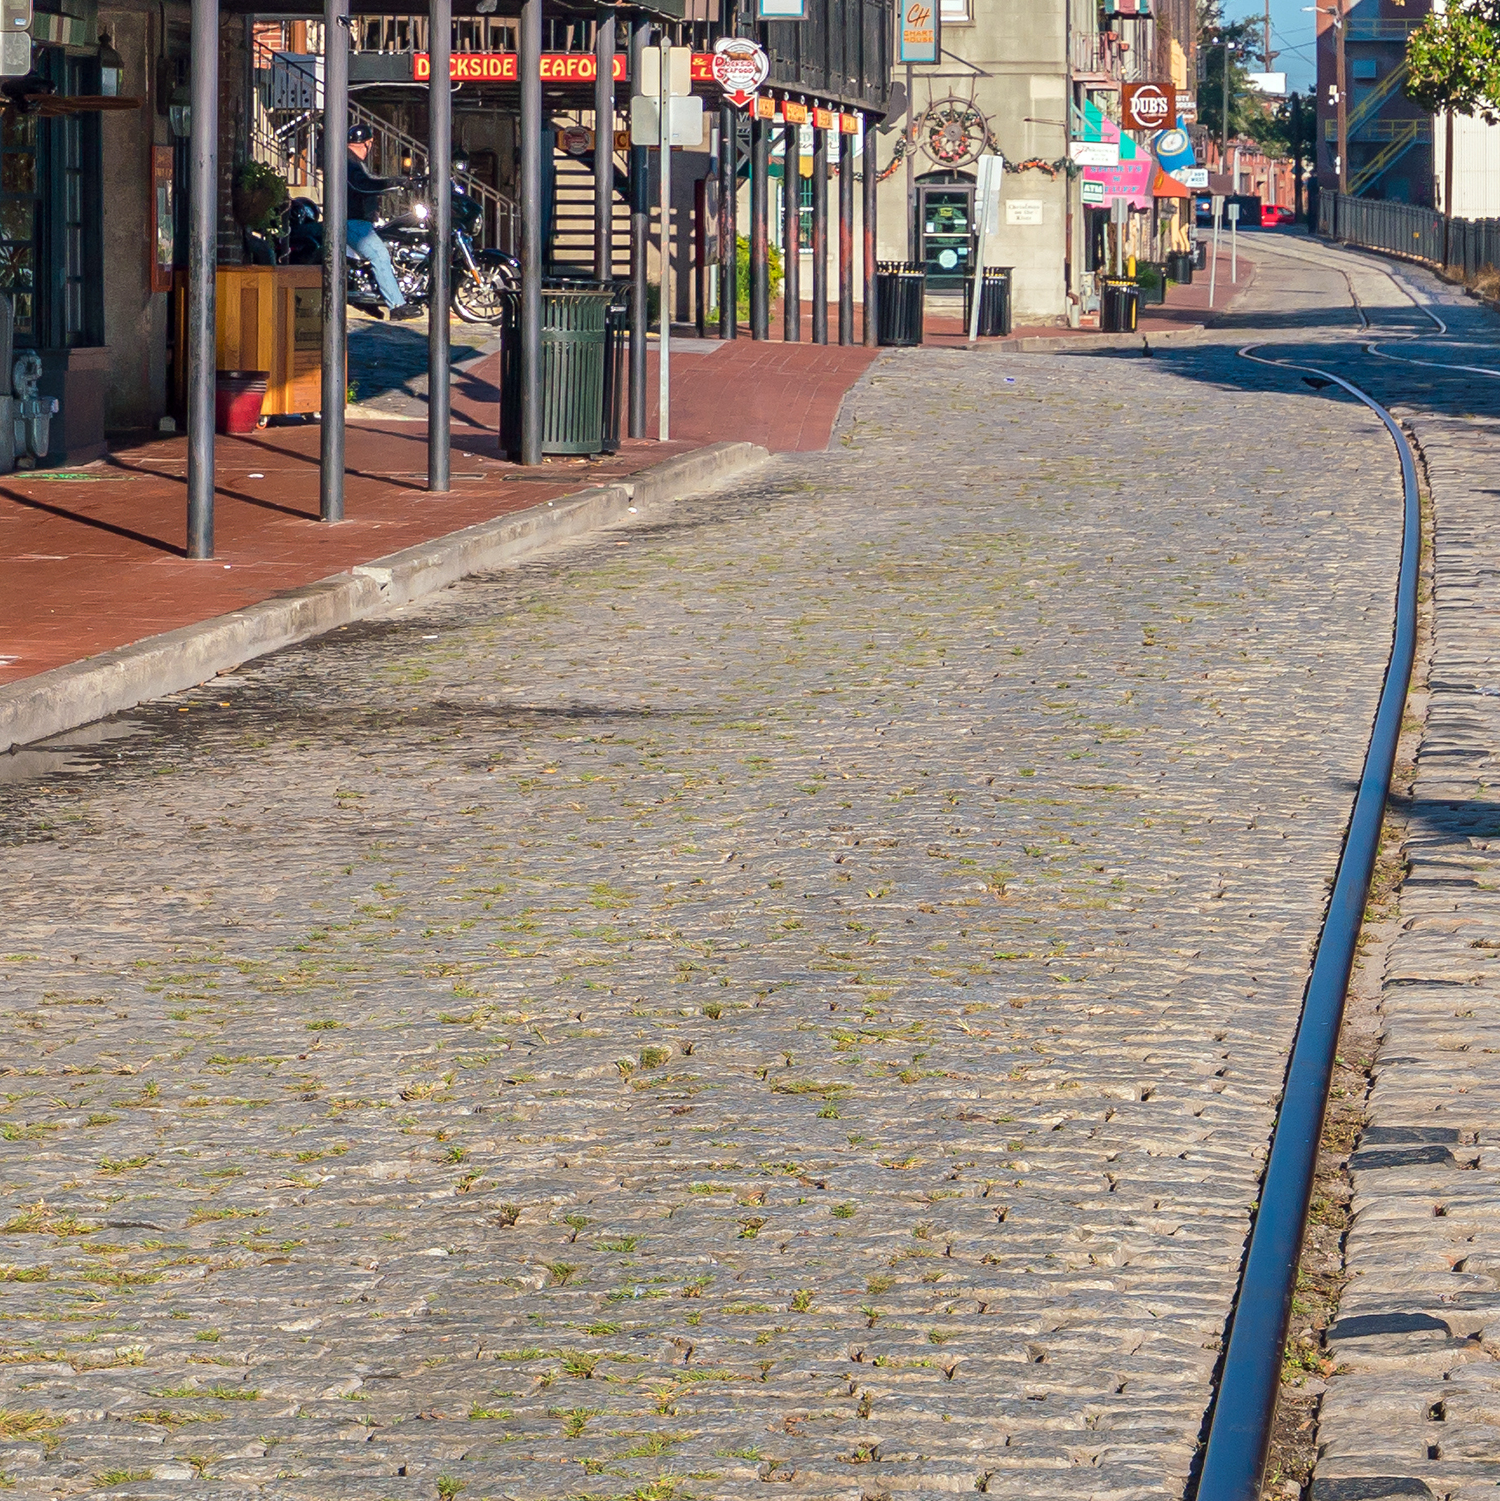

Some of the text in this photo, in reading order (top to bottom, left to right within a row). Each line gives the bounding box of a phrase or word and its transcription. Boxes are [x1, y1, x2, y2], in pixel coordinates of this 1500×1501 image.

[903, 36, 934, 44] HOUSE
[417, 57, 621, 77] DCKSIDE EAFOD
[1129, 97, 1169, 114] DUB'S
[1083, 183, 1103, 193] ATM
